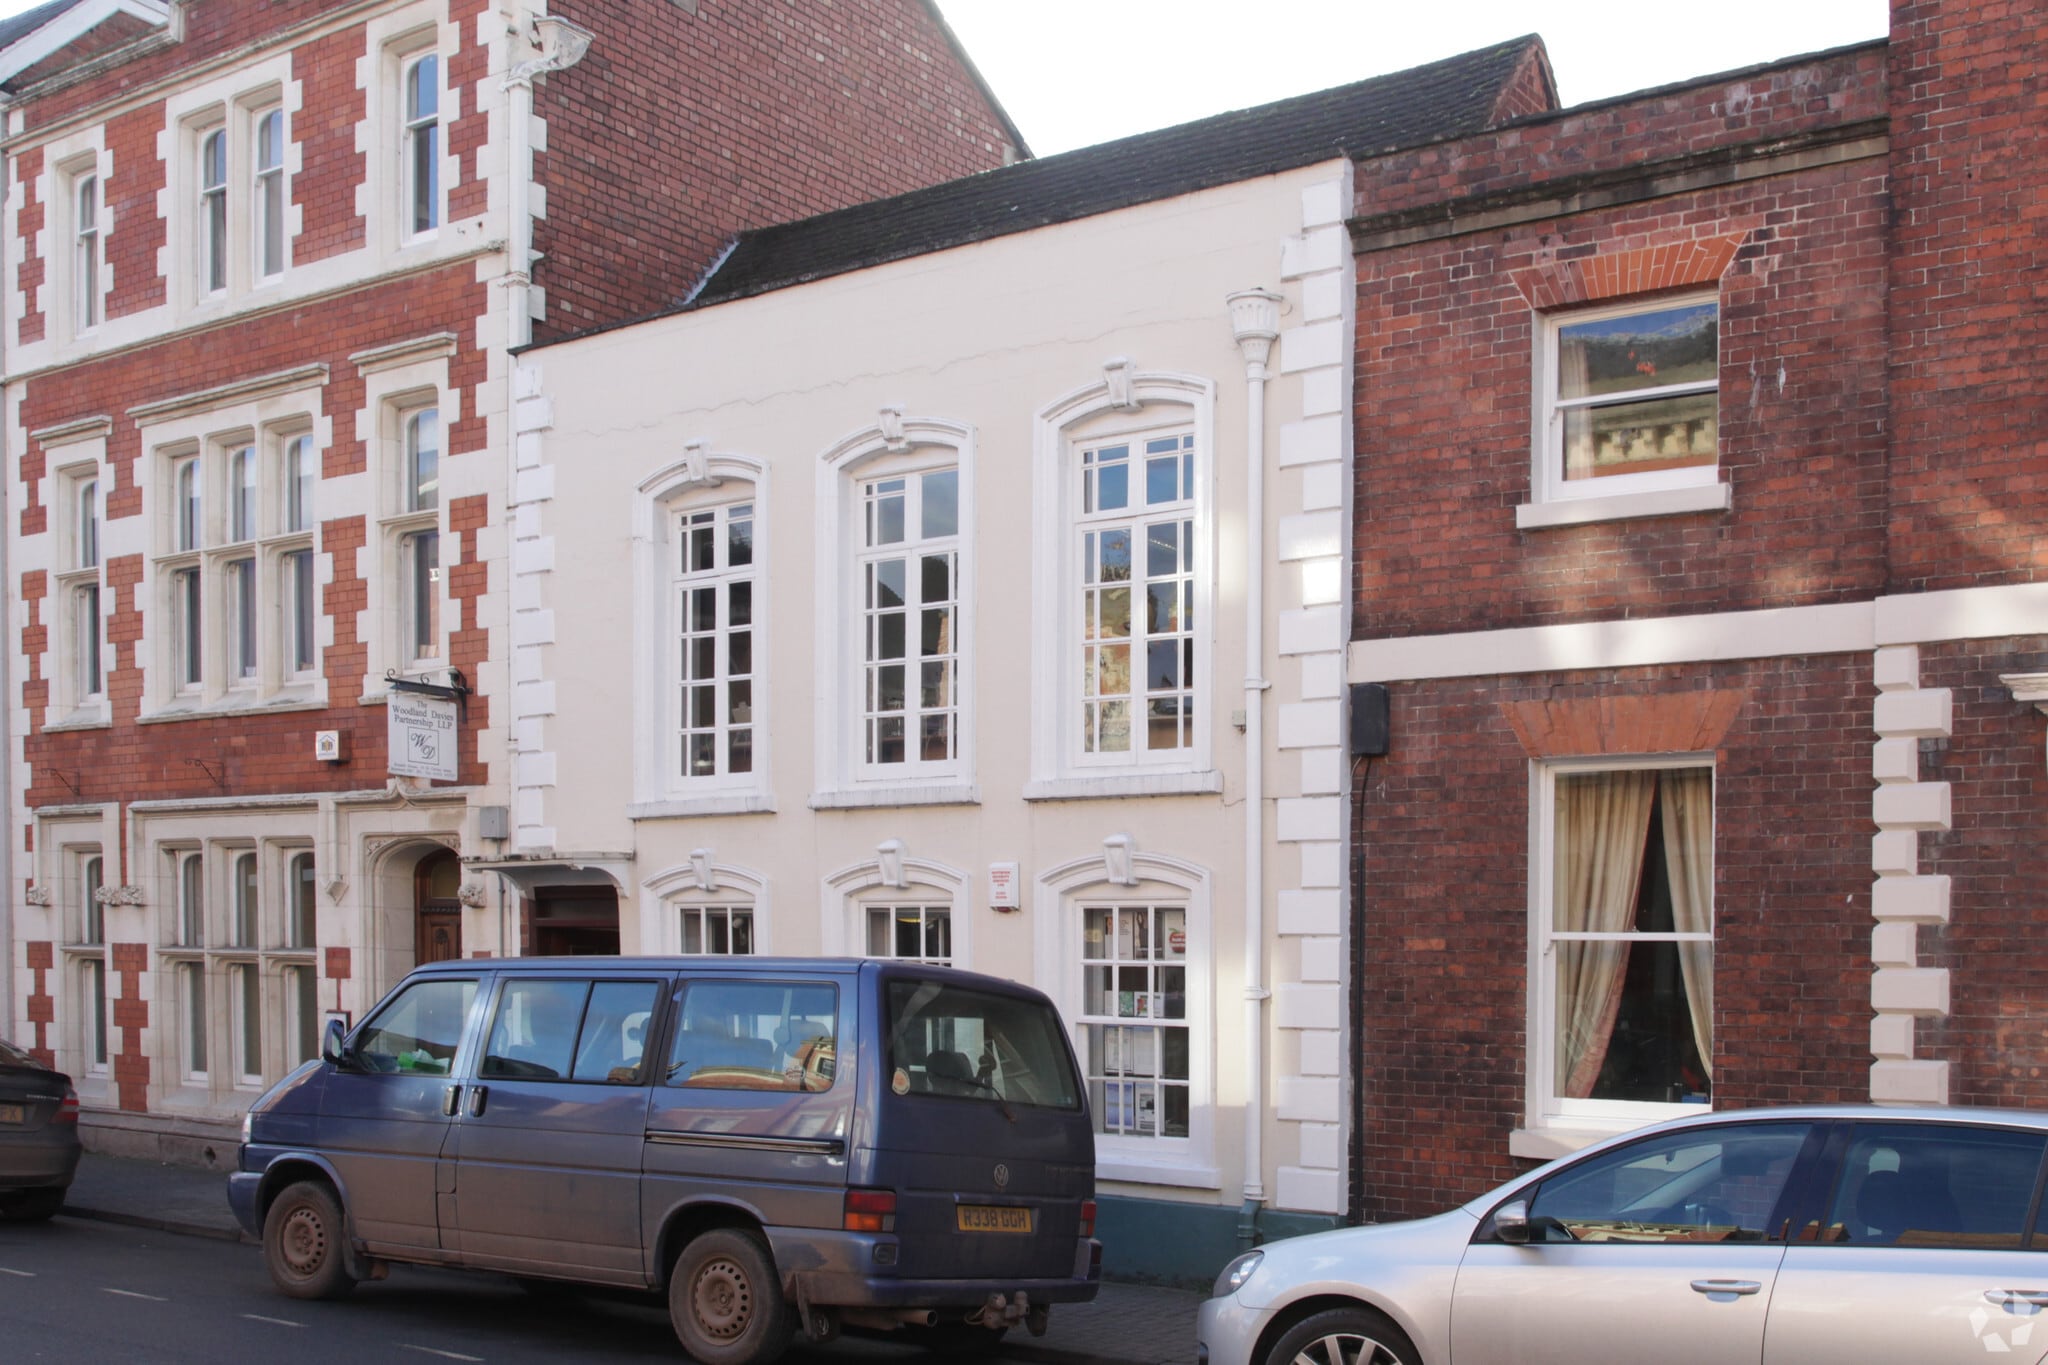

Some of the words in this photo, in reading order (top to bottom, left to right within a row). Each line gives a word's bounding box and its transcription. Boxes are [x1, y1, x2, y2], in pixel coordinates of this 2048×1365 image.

[416, 700, 427, 708] The
[392, 705, 427, 717] Woodland
[431, 710, 454, 721] Davies
[394, 714, 433, 728] Partnership
[437, 720, 453, 730] LLP
